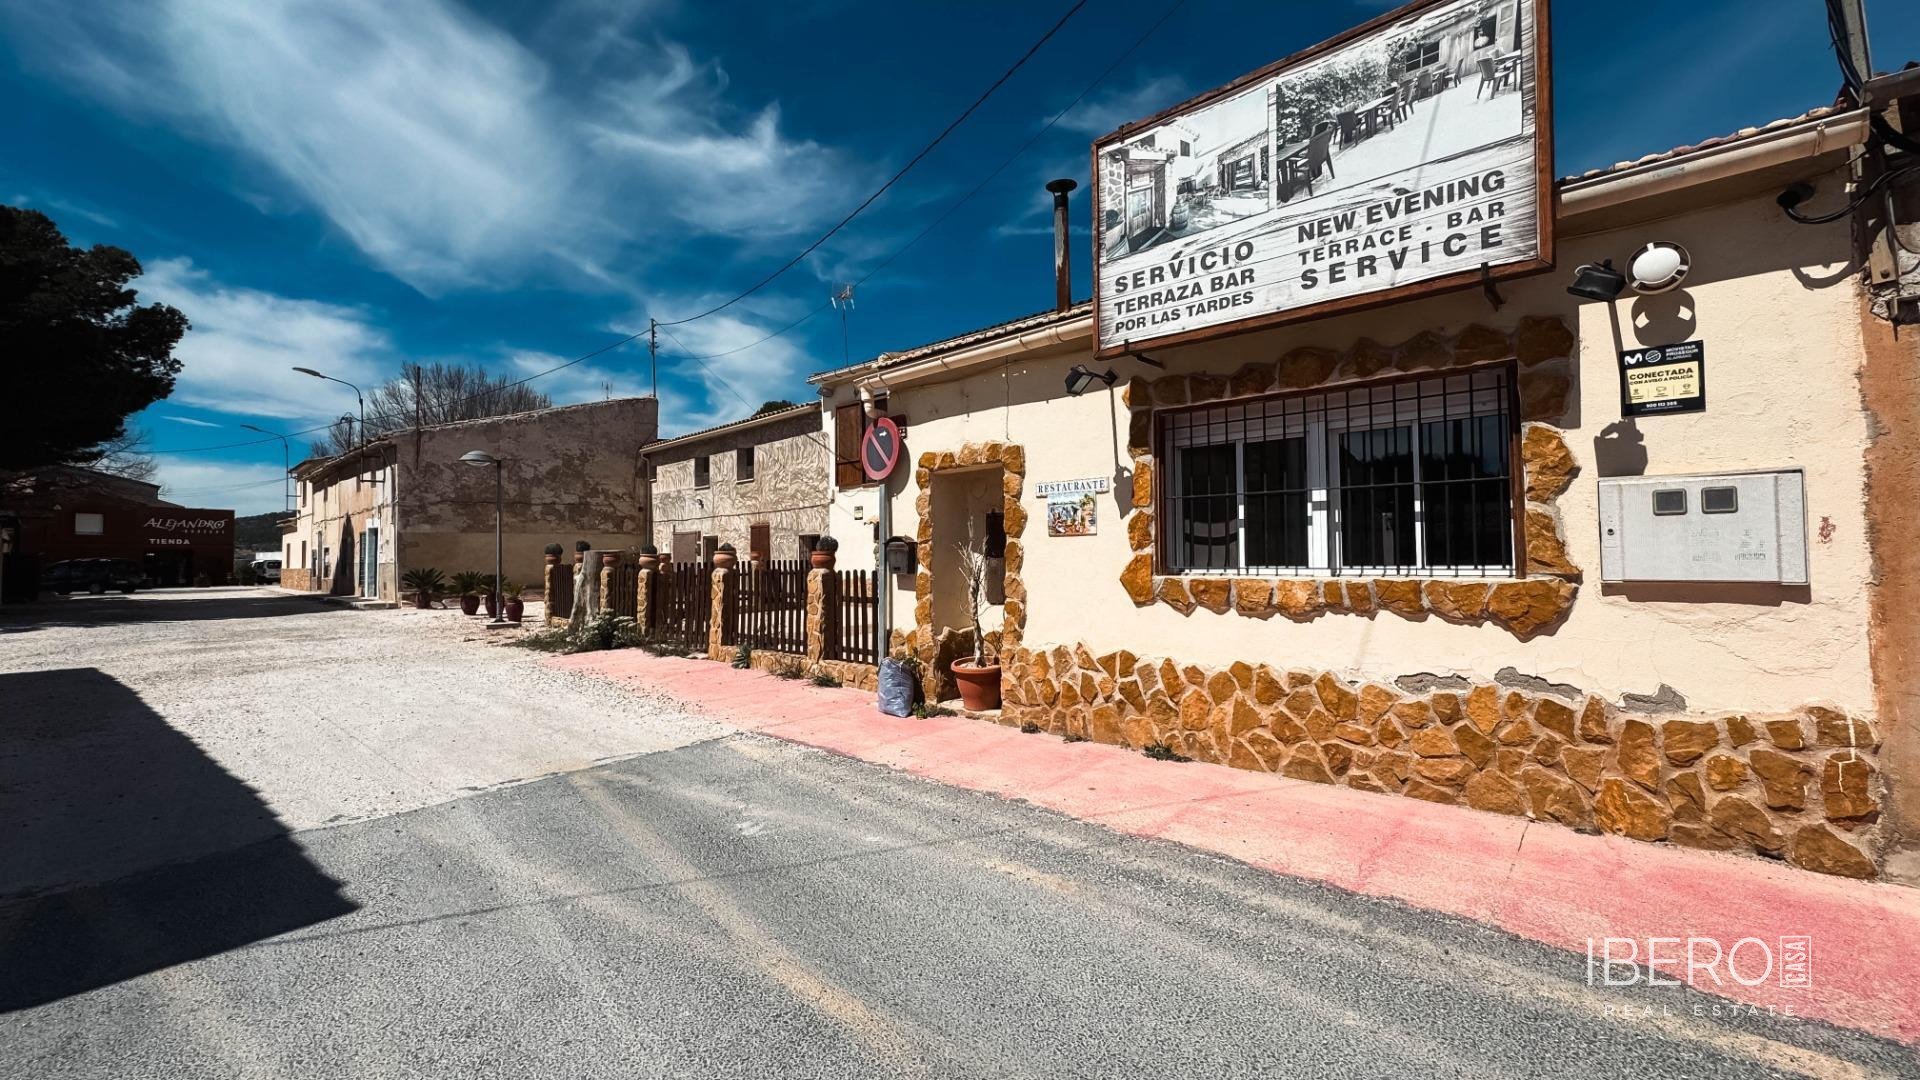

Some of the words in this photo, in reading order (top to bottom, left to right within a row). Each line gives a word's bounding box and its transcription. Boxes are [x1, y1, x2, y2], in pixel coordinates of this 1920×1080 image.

[1298, 211, 1356, 243] NEW
[1366, 170, 1505, 225] EVENING
[1298, 225, 1412, 265] TERRACE
[1447, 201, 1505, 229] BAR
[1301, 223, 1503, 290] SERVICE
[1114, 281, 1203, 316] TERRAZA
[1211, 268, 1255, 292] BAR
[1115, 241, 1254, 293] SERVICIO
[1115, 316, 1146, 333] POR
[1151, 308, 1181, 325] LAS
[1186, 291, 1254, 317] TARDES
[1629, 367, 1693, 380] CONECTADA
[1038, 480, 1105, 493] RESTAURANTE
